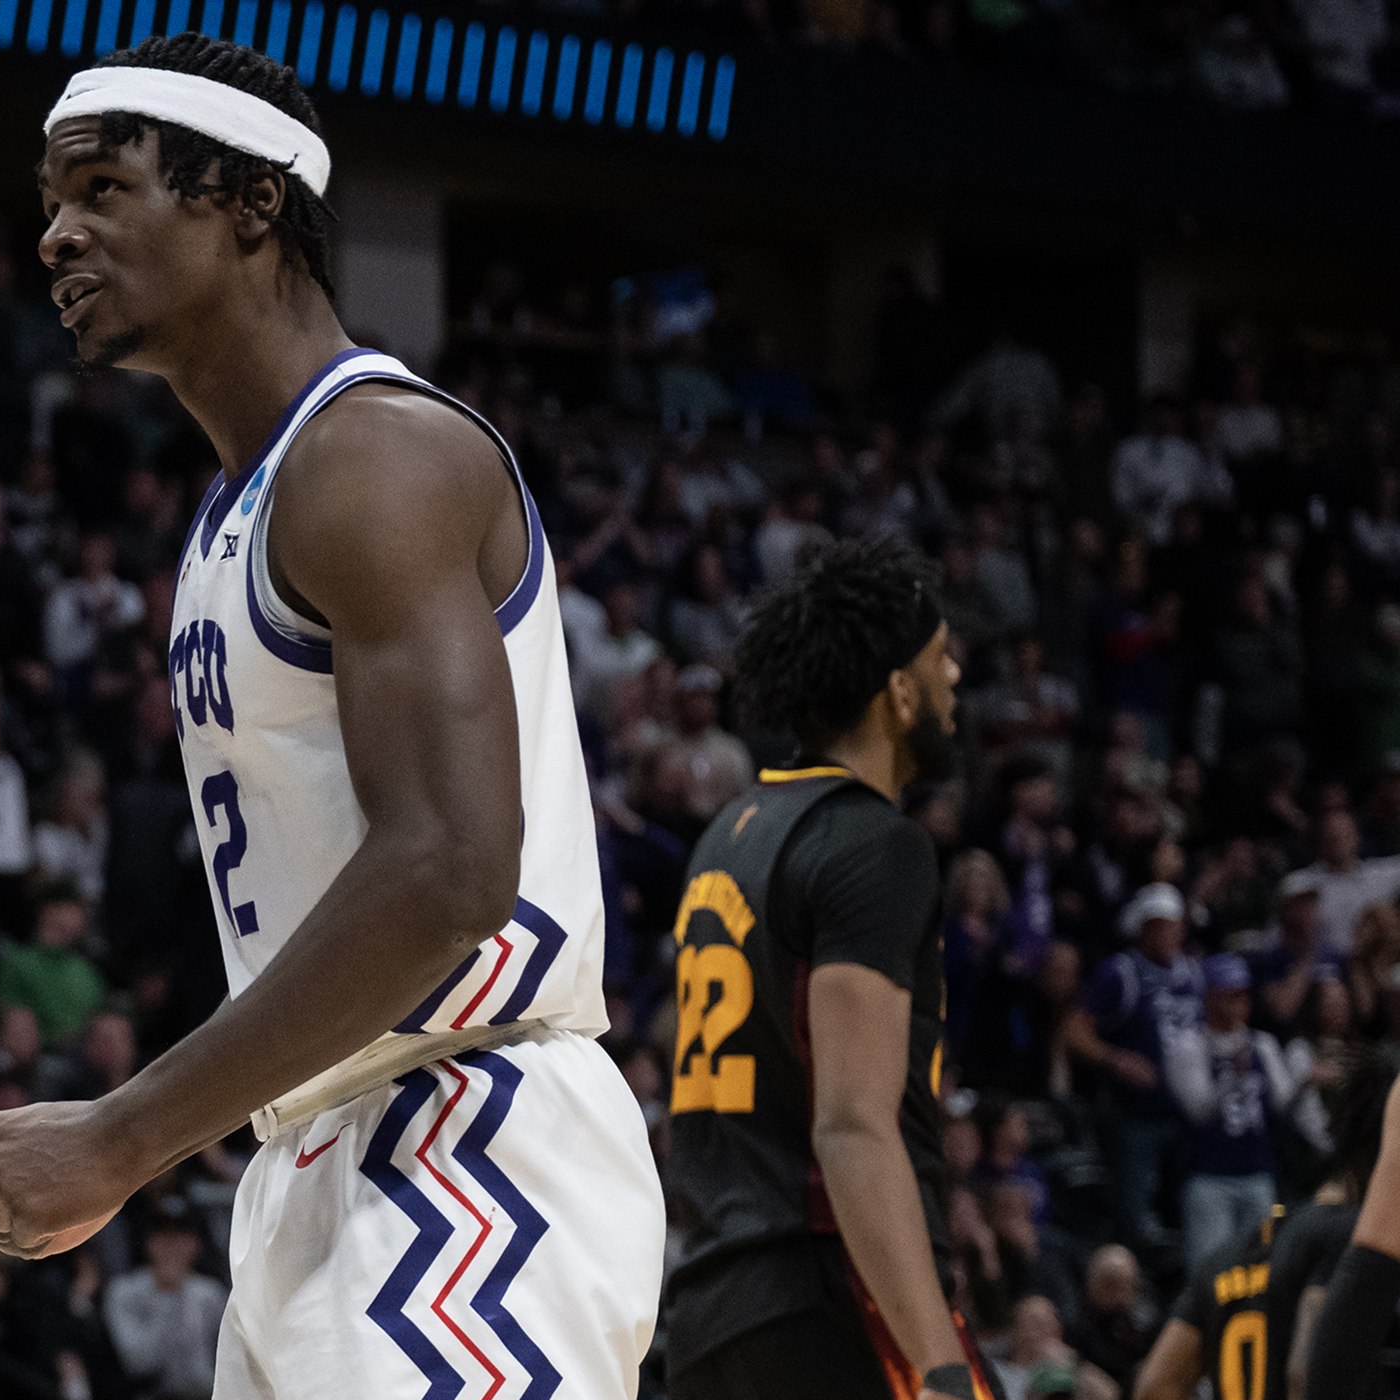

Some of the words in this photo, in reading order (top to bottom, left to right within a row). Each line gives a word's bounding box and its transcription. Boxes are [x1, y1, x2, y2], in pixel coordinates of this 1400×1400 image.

[169, 617, 236, 745] TCU
[200, 768, 261, 940] 2
[669, 942, 757, 1115] 22
